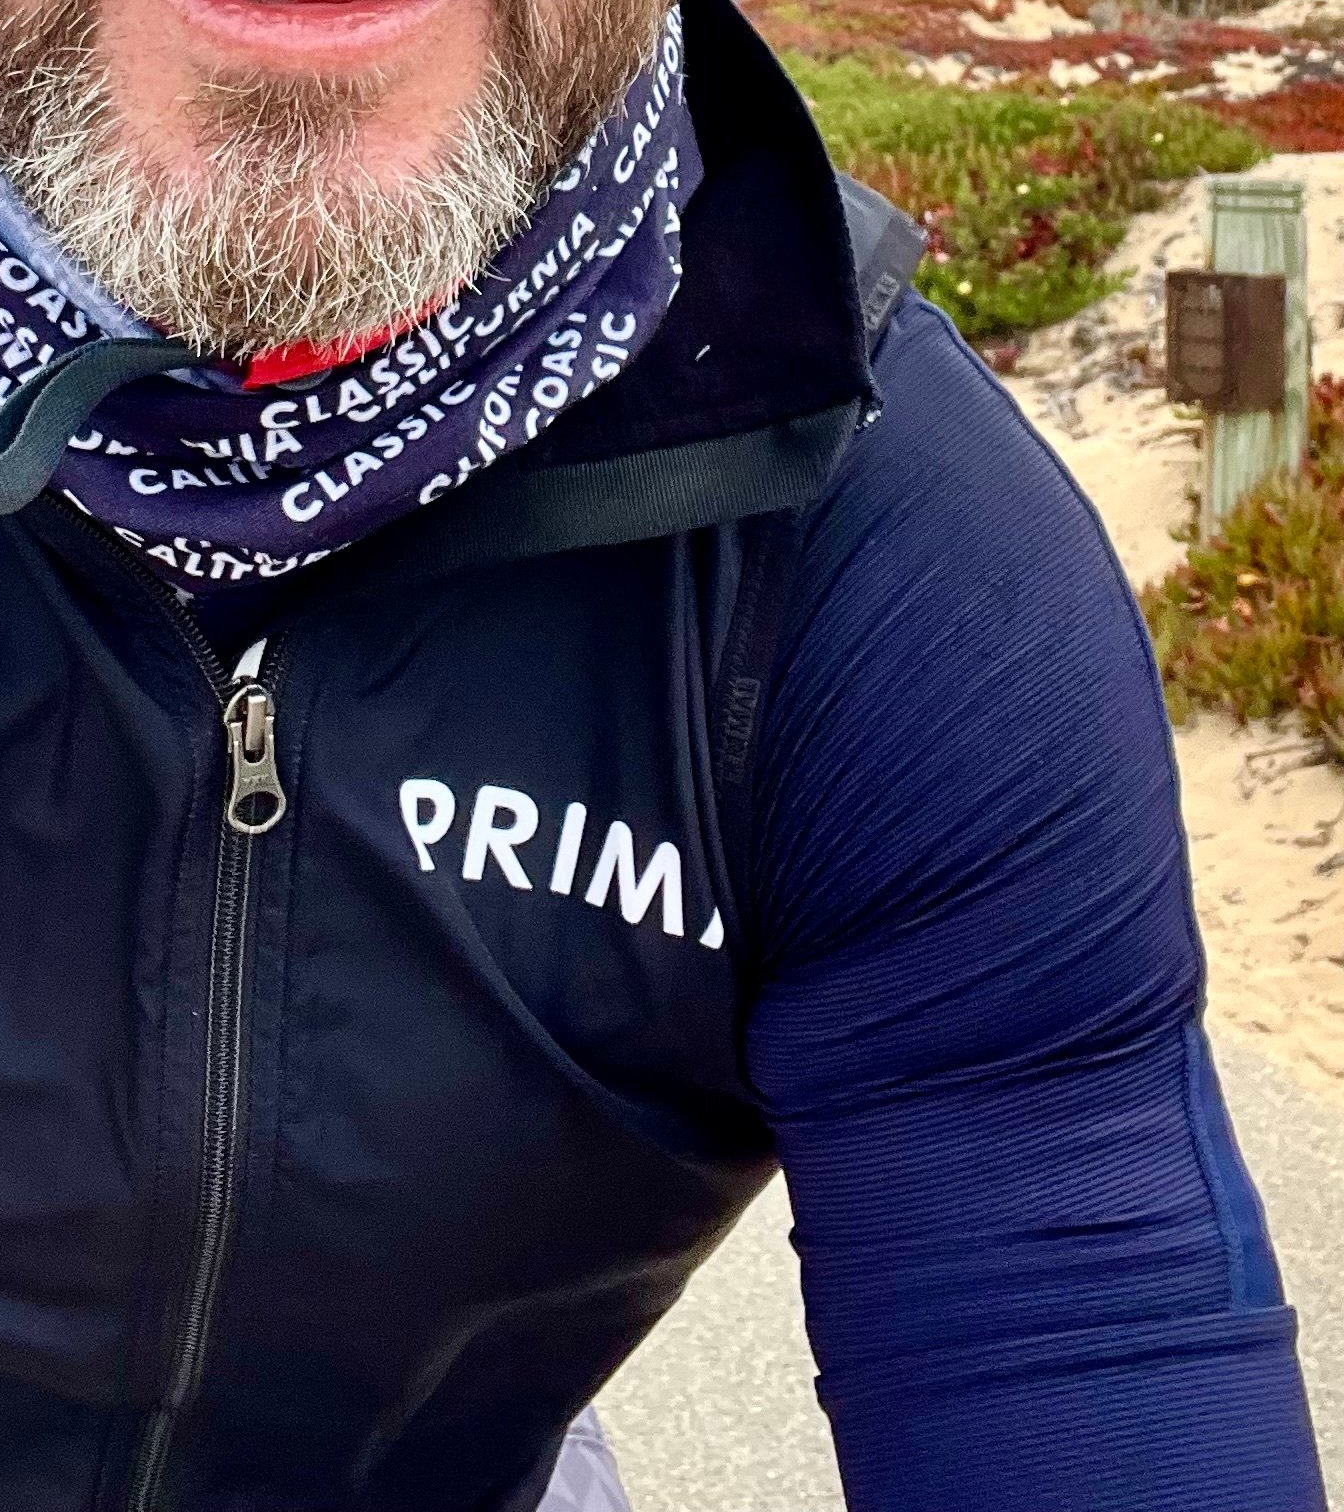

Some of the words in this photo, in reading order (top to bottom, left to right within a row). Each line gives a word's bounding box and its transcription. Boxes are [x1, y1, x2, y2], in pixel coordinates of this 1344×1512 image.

[259, 303, 475, 430] CLASSIC
[281, 380, 477, 522] CLASSIC
[399, 778, 724, 950] PRIM
